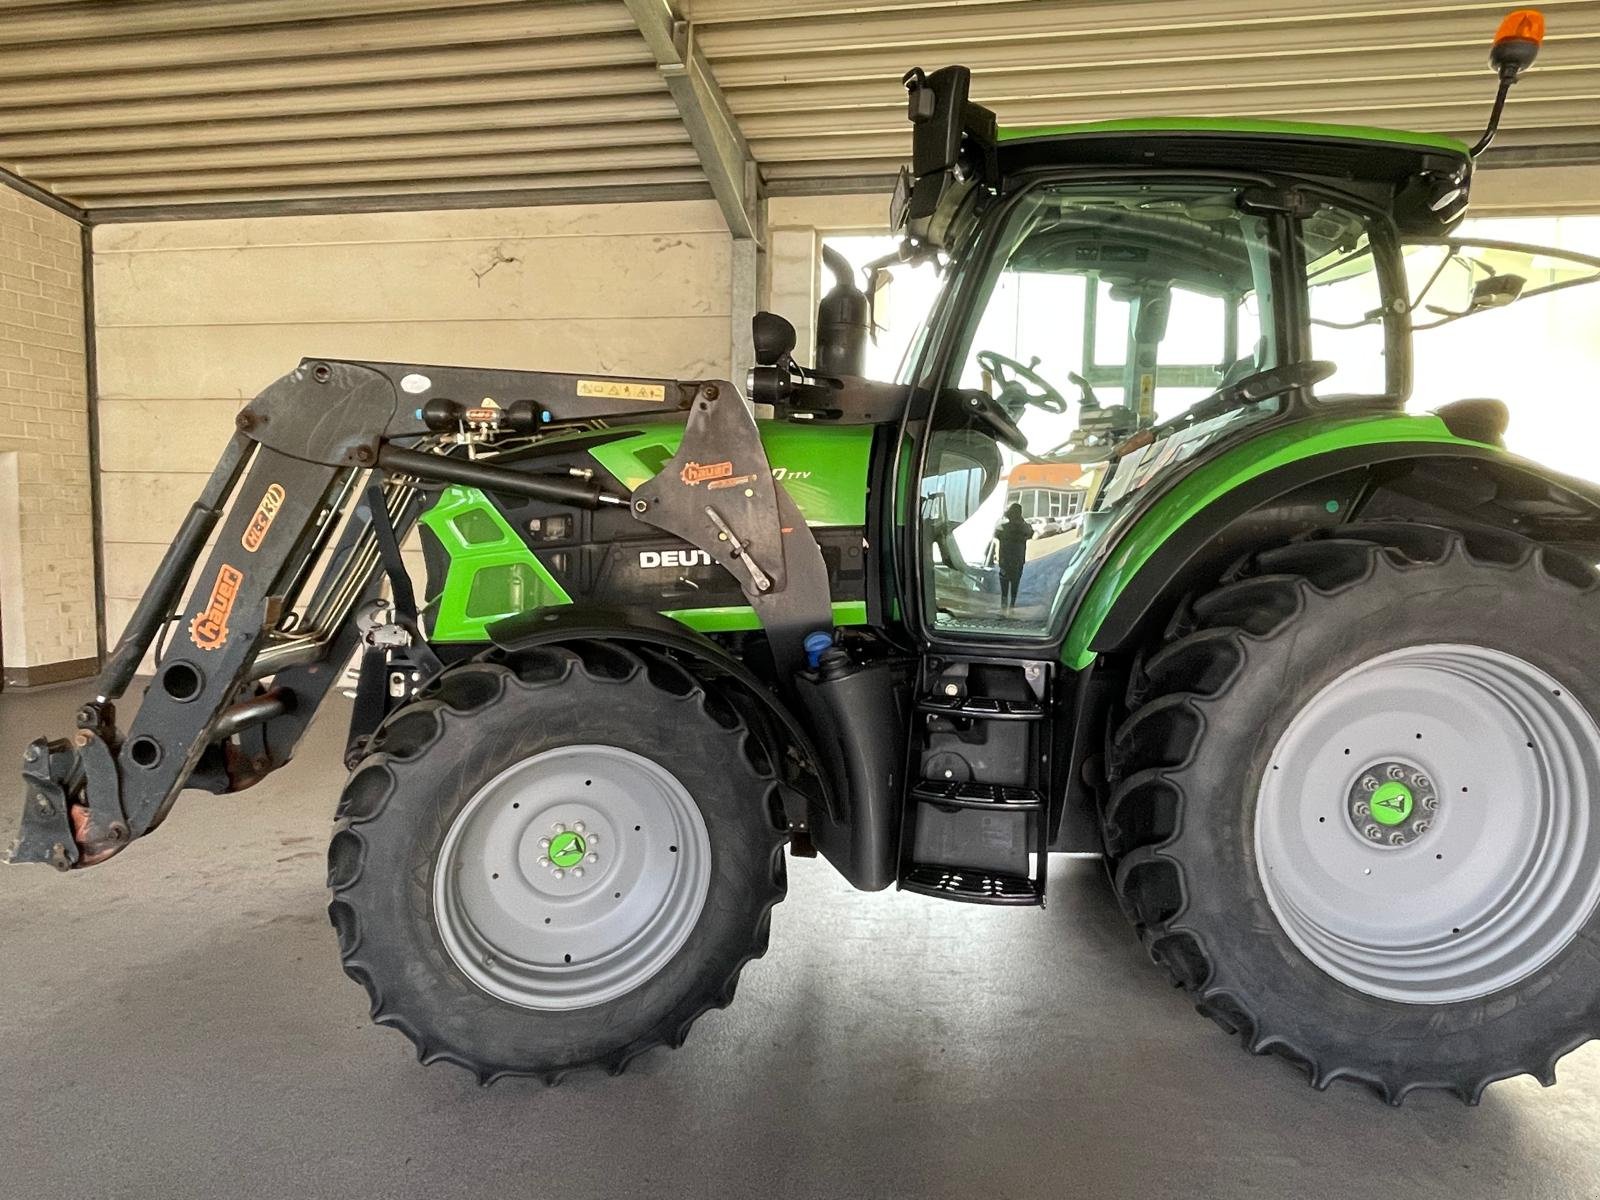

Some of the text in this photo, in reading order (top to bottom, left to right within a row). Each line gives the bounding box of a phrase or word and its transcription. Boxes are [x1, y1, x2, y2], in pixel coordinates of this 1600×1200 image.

[787, 471, 811, 480] TTV
[640, 550, 718, 569] DEUT
[196, 568, 240, 643] hauer
